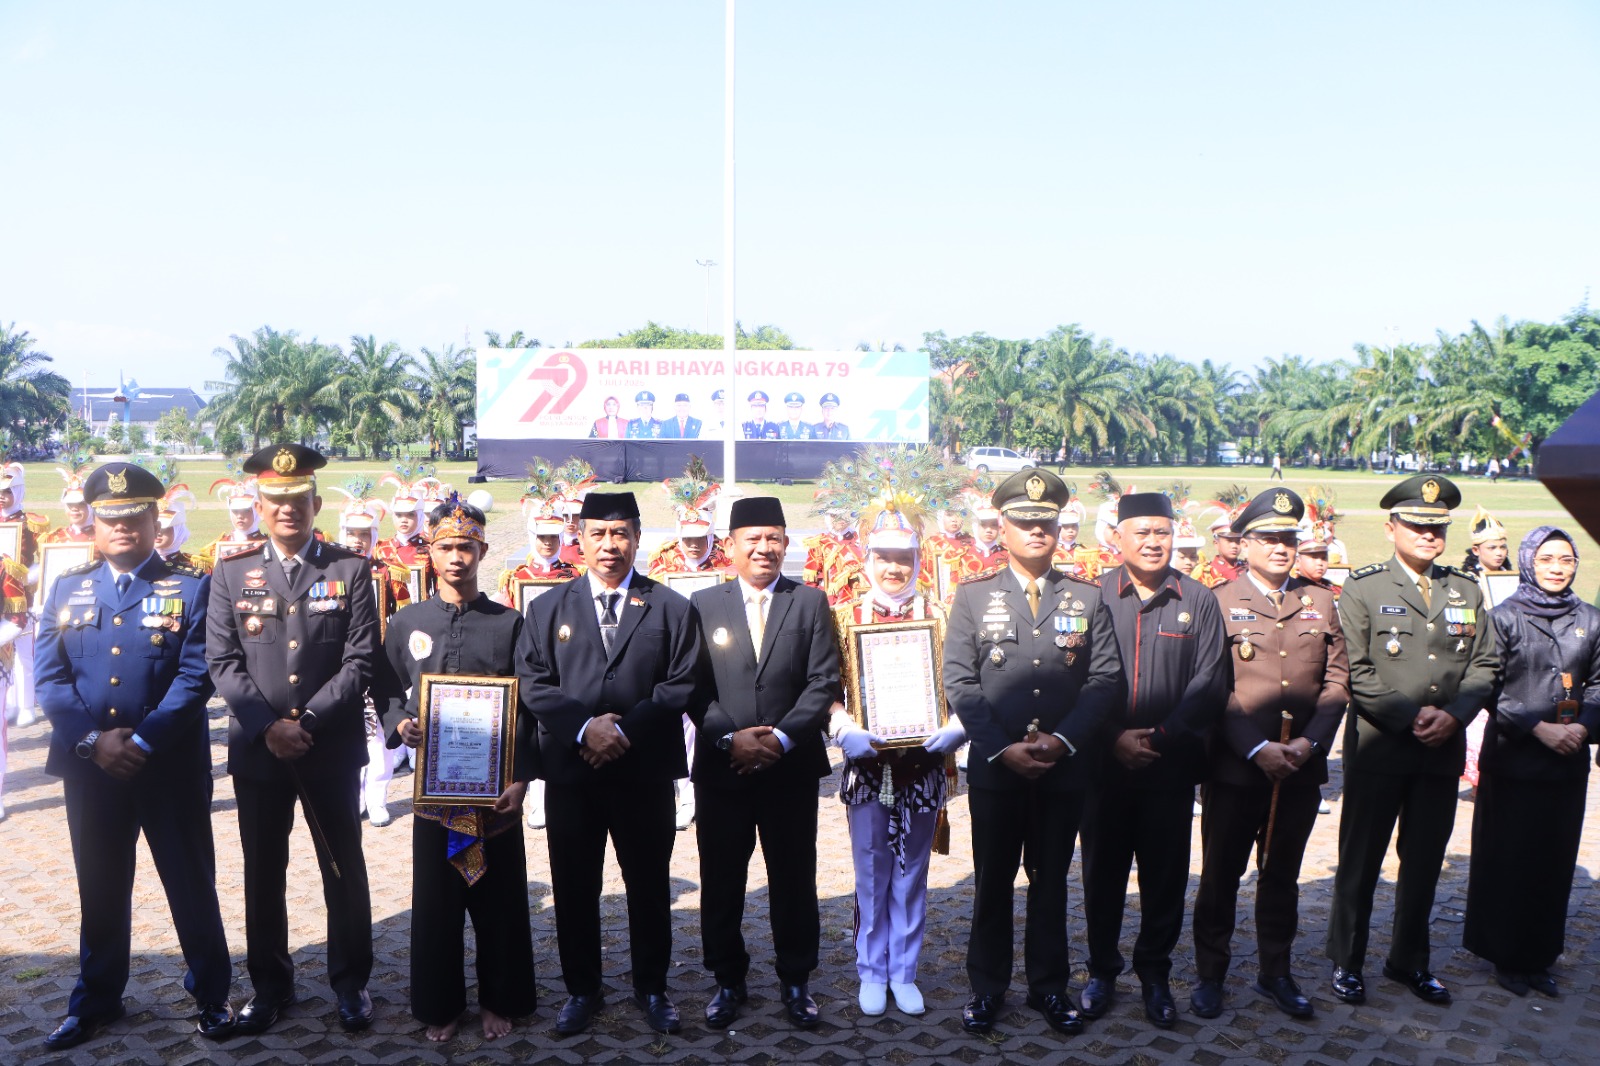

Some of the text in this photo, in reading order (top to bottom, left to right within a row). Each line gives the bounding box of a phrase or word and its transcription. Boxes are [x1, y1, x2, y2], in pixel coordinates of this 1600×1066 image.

[598, 359, 850, 377] HARI BHAYANGKARA 79
[604, 379, 622, 387] JULI
[624, 379, 645, 387] 2025
